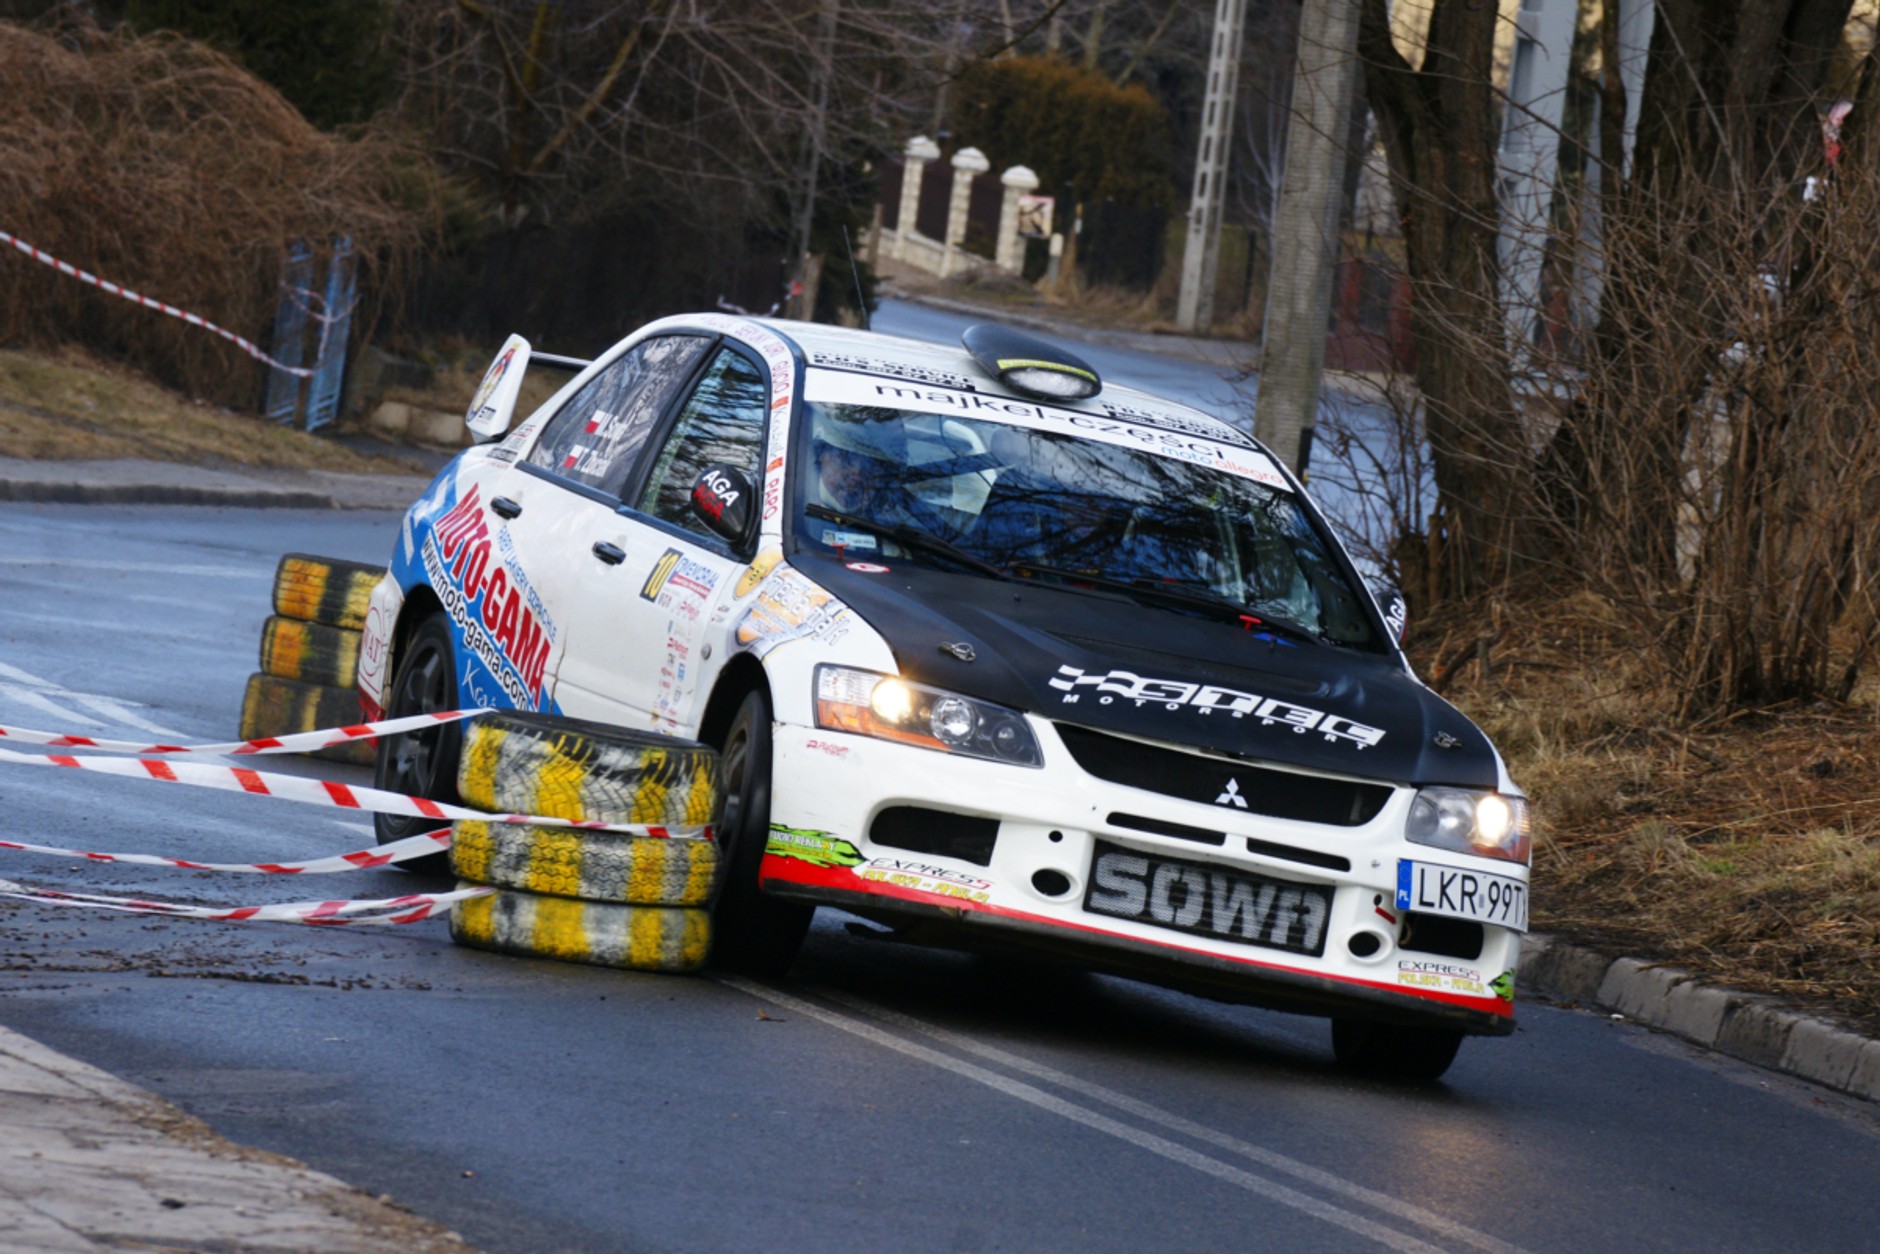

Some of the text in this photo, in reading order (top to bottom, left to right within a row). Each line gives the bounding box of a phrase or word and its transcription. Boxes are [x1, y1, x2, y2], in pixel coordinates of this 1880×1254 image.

[702, 470, 740, 507] AGA
[436, 482, 551, 709] MOTO-GAMA
[1062, 694, 1368, 750] MOTORSPORT
[870, 858, 991, 890] EXPRESS
[1419, 868, 1478, 915] LKR
[1397, 960, 1480, 982] EXPRESS
